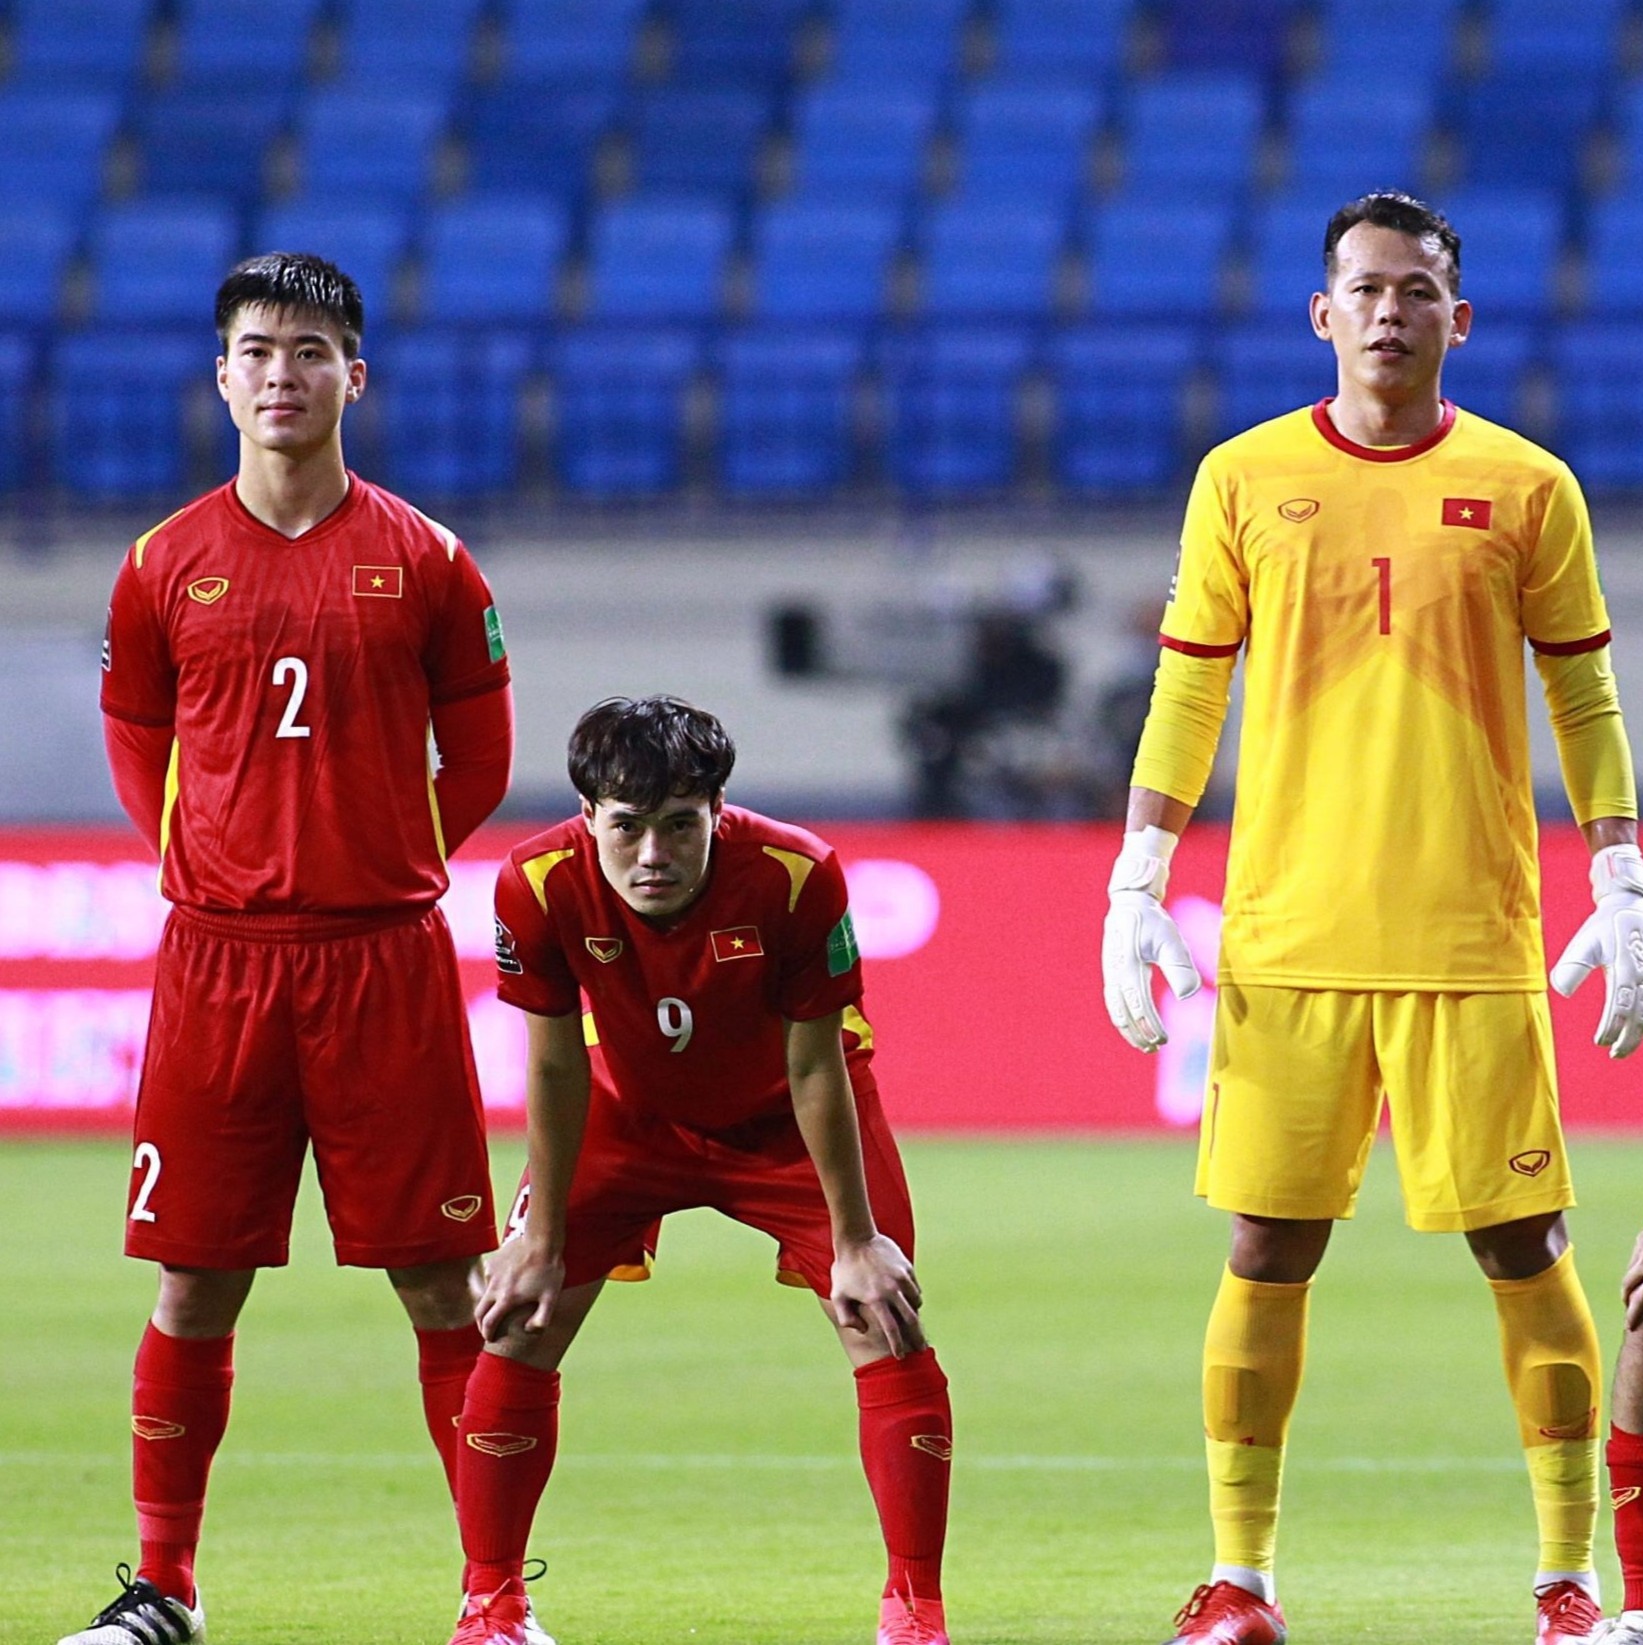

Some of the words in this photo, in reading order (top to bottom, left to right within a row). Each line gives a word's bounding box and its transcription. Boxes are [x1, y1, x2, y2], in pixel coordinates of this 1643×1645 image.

[1372, 557, 1391, 635] 1
[272, 656, 311, 738] 2
[657, 997, 693, 1053] 9
[130, 1142, 162, 1222] 2
